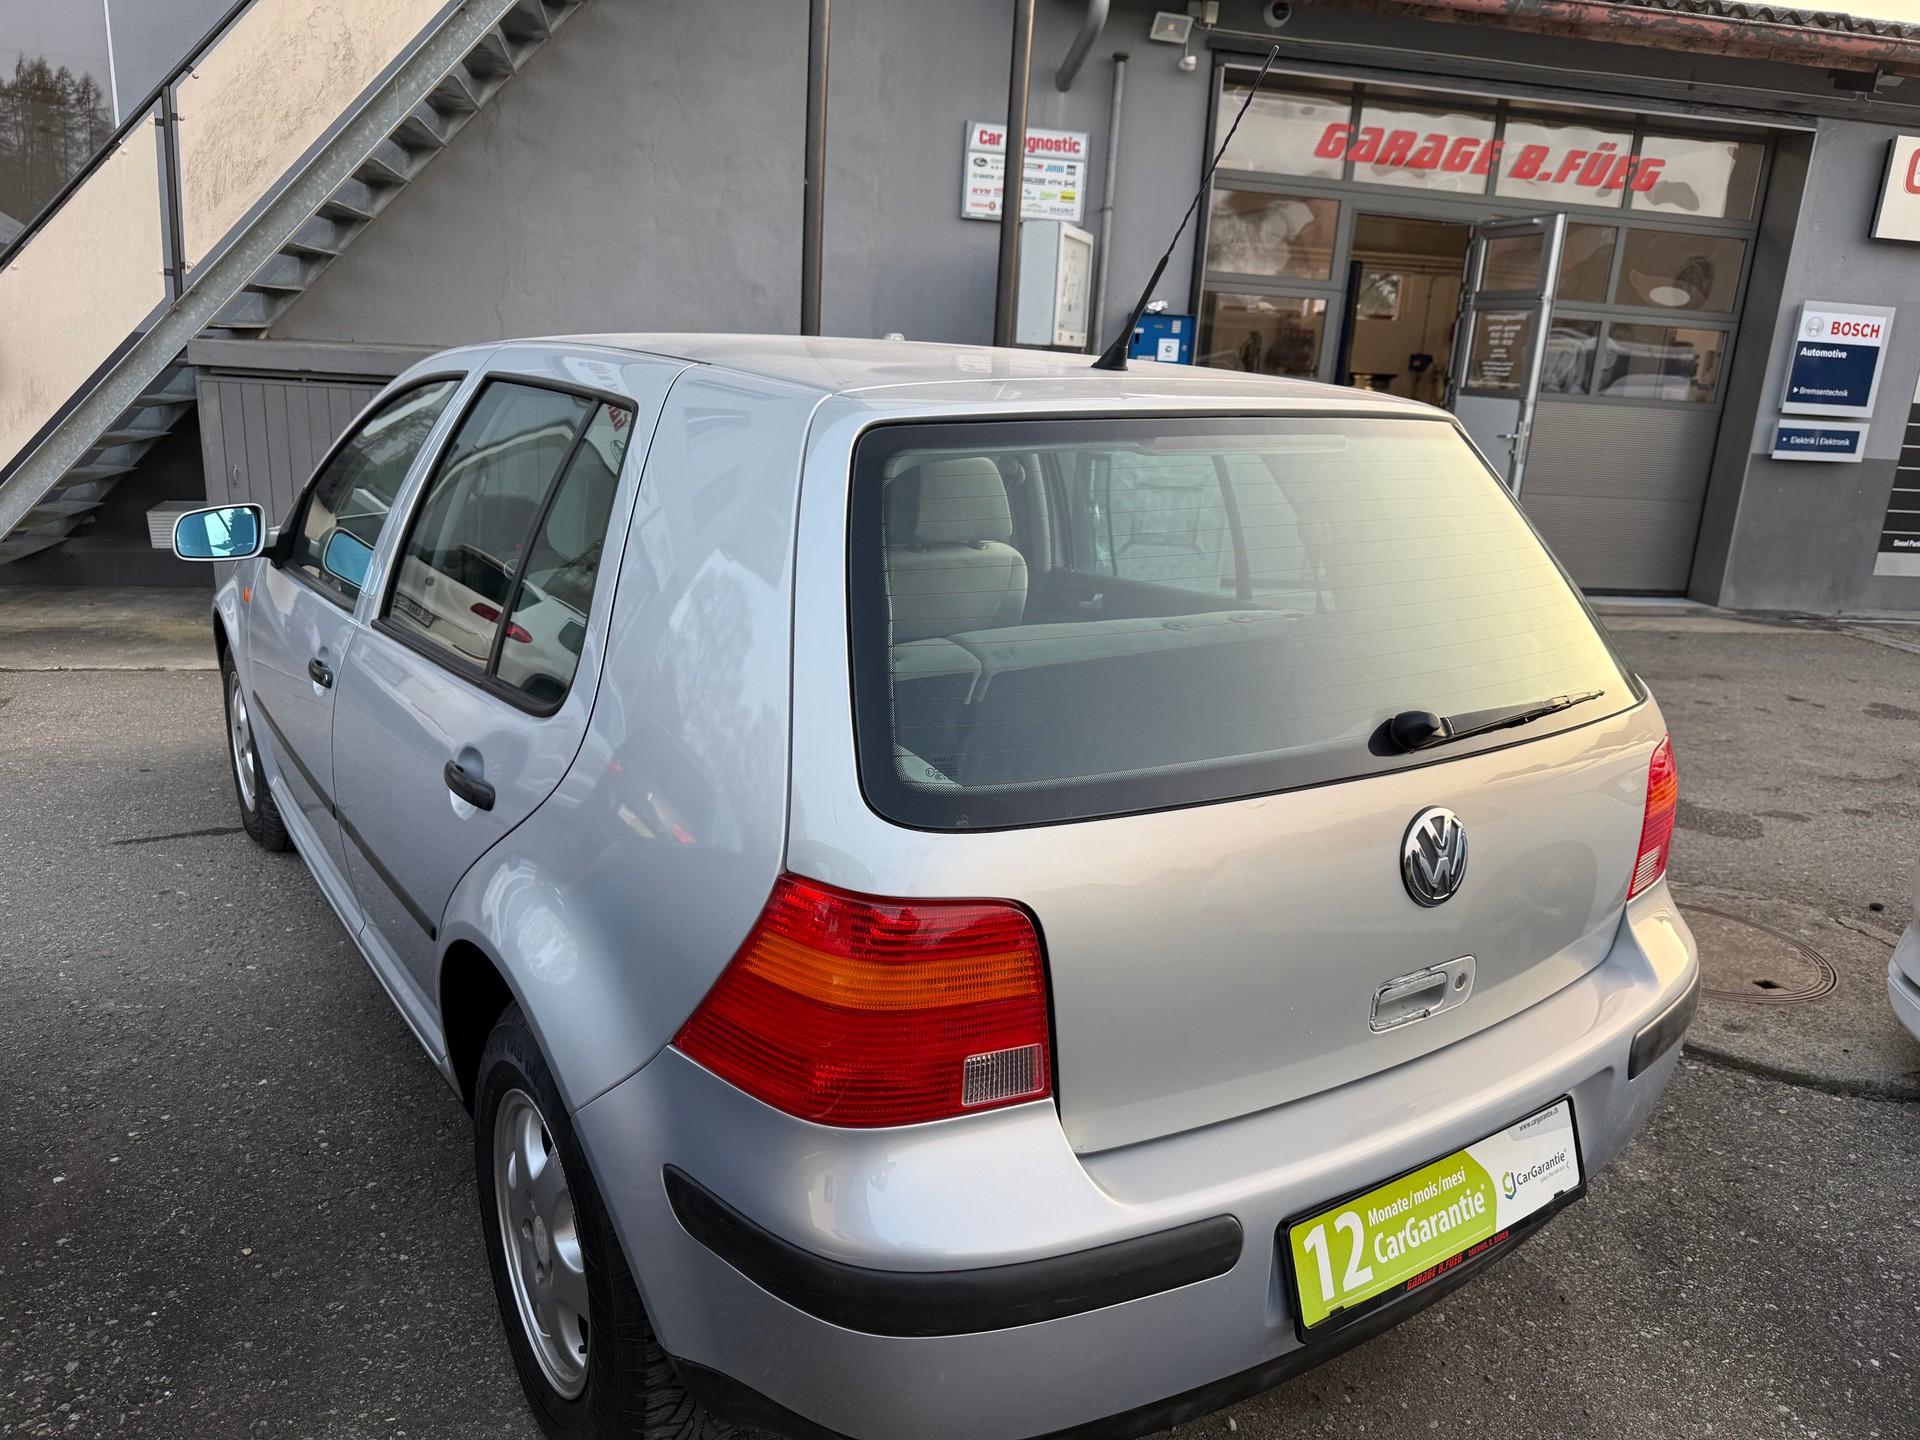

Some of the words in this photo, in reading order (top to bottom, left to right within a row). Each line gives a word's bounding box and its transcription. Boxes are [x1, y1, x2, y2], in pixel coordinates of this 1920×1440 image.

[979, 129, 1003, 146] Car
[1024, 136, 1081, 154] gnostic
[1830, 321, 1880, 339] BOSCH
[1800, 346, 1848, 359] Automotive
[1799, 386, 1849, 398] Bremsentechnik
[1790, 435, 1815, 445] Elektrik
[1819, 437, 1851, 447] Elektronik
[1518, 1106, 1559, 1132] www.cargarantie.ch
[1368, 1166, 1466, 1228] Monate/mois/mesi
[1302, 1211, 1374, 1302] 12
[1407, 1266, 1437, 1291] GARAGE
